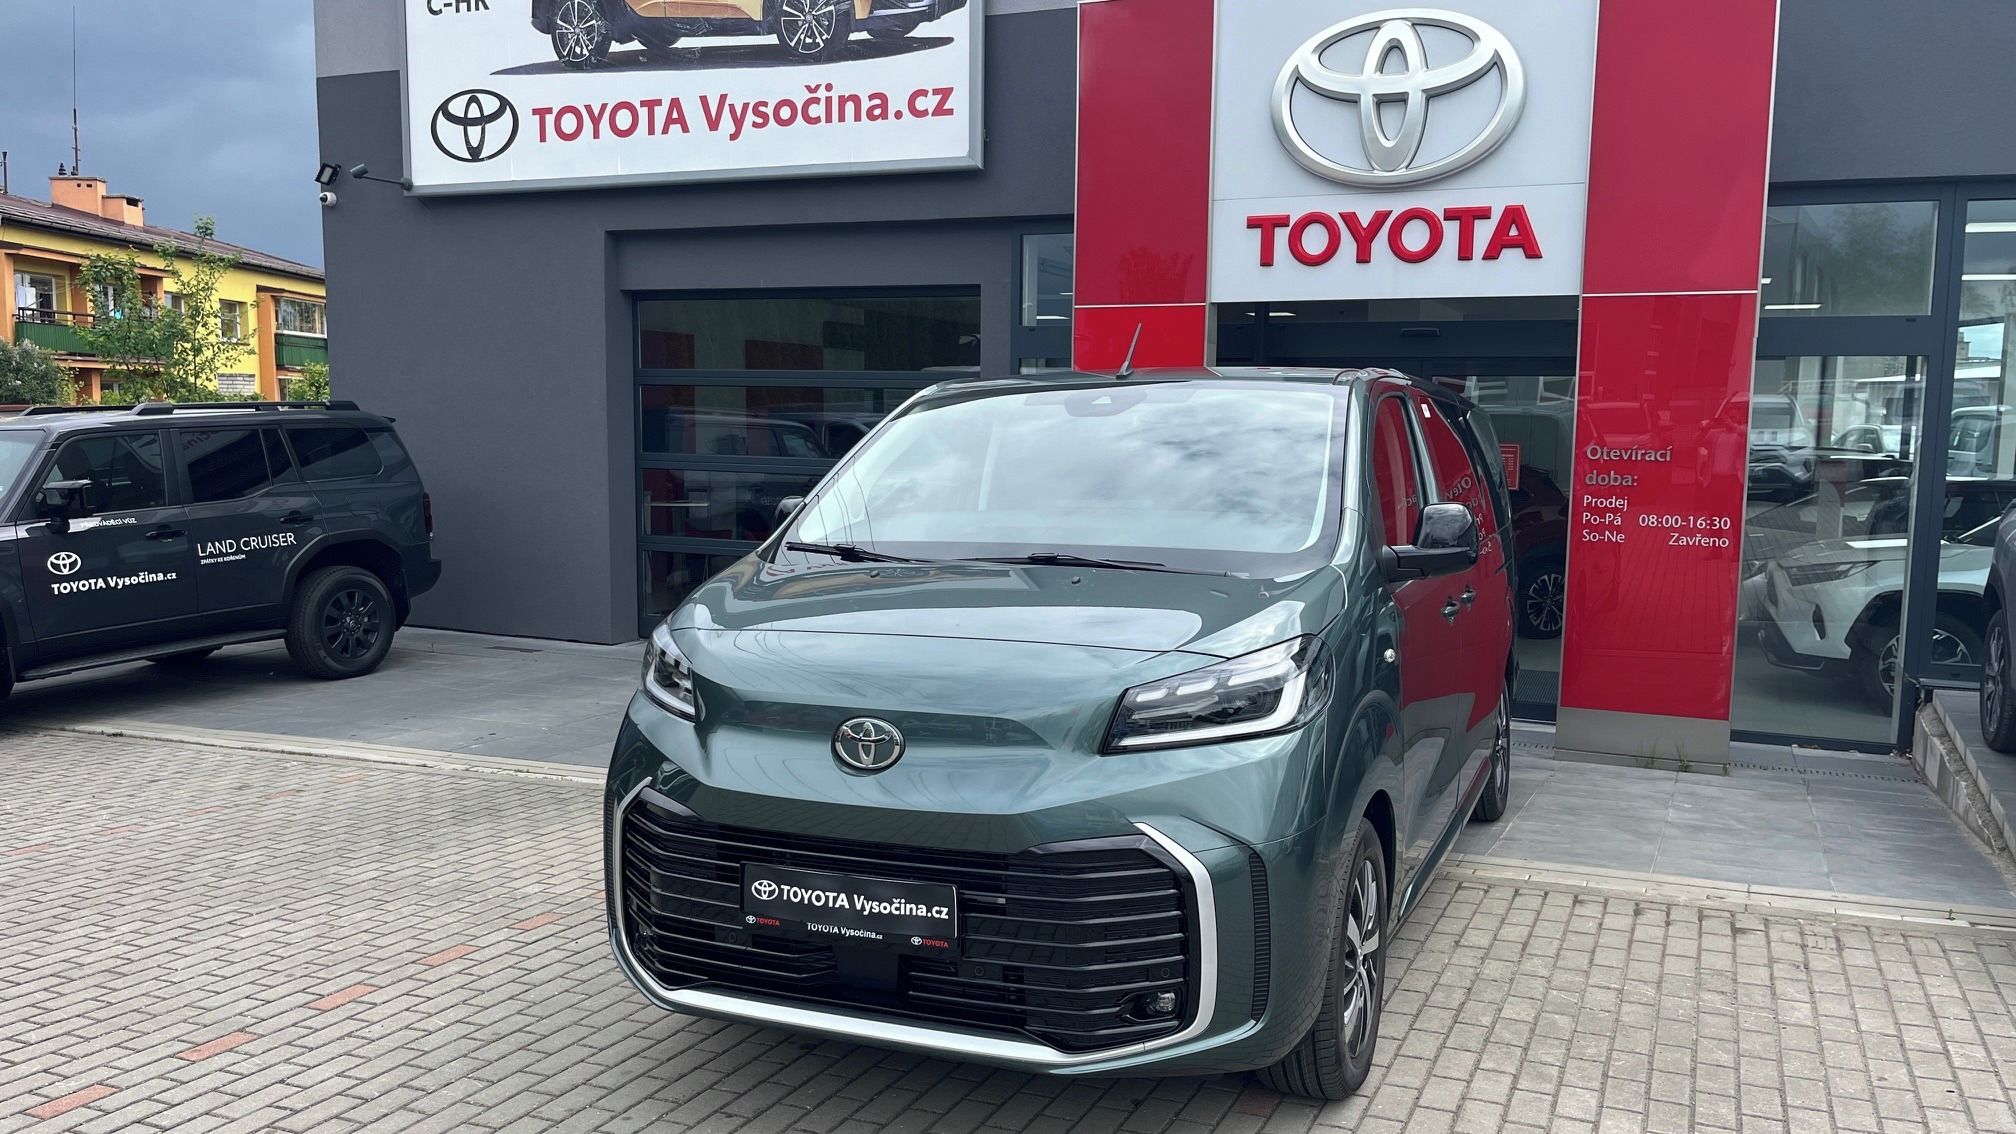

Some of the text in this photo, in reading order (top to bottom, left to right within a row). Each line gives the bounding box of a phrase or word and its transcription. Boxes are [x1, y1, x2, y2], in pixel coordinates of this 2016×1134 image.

[532, 83, 955, 144] TOYOTA Vysočina.cz
[1247, 204, 1543, 267] TOYOTA
[1586, 444, 1673, 462] Otevírací
[1585, 470, 1638, 486] doba:
[1583, 495, 1628, 512] Prodej
[1582, 512, 1731, 530] Po-Pá 08:00-16:30
[197, 532, 297, 557] LAND CRUISER
[1582, 529, 1730, 548] So-Ne Zavřeno
[51, 571, 177, 595] TOYOTA Vysočina.cz
[781, 884, 949, 920] TOYOTA Vysočina.cz
[756, 917, 780, 927] TOYOTA
[806, 921, 883, 940] TOYOTA Vysočina.cz
[922, 938, 949, 948] TOYOTA
